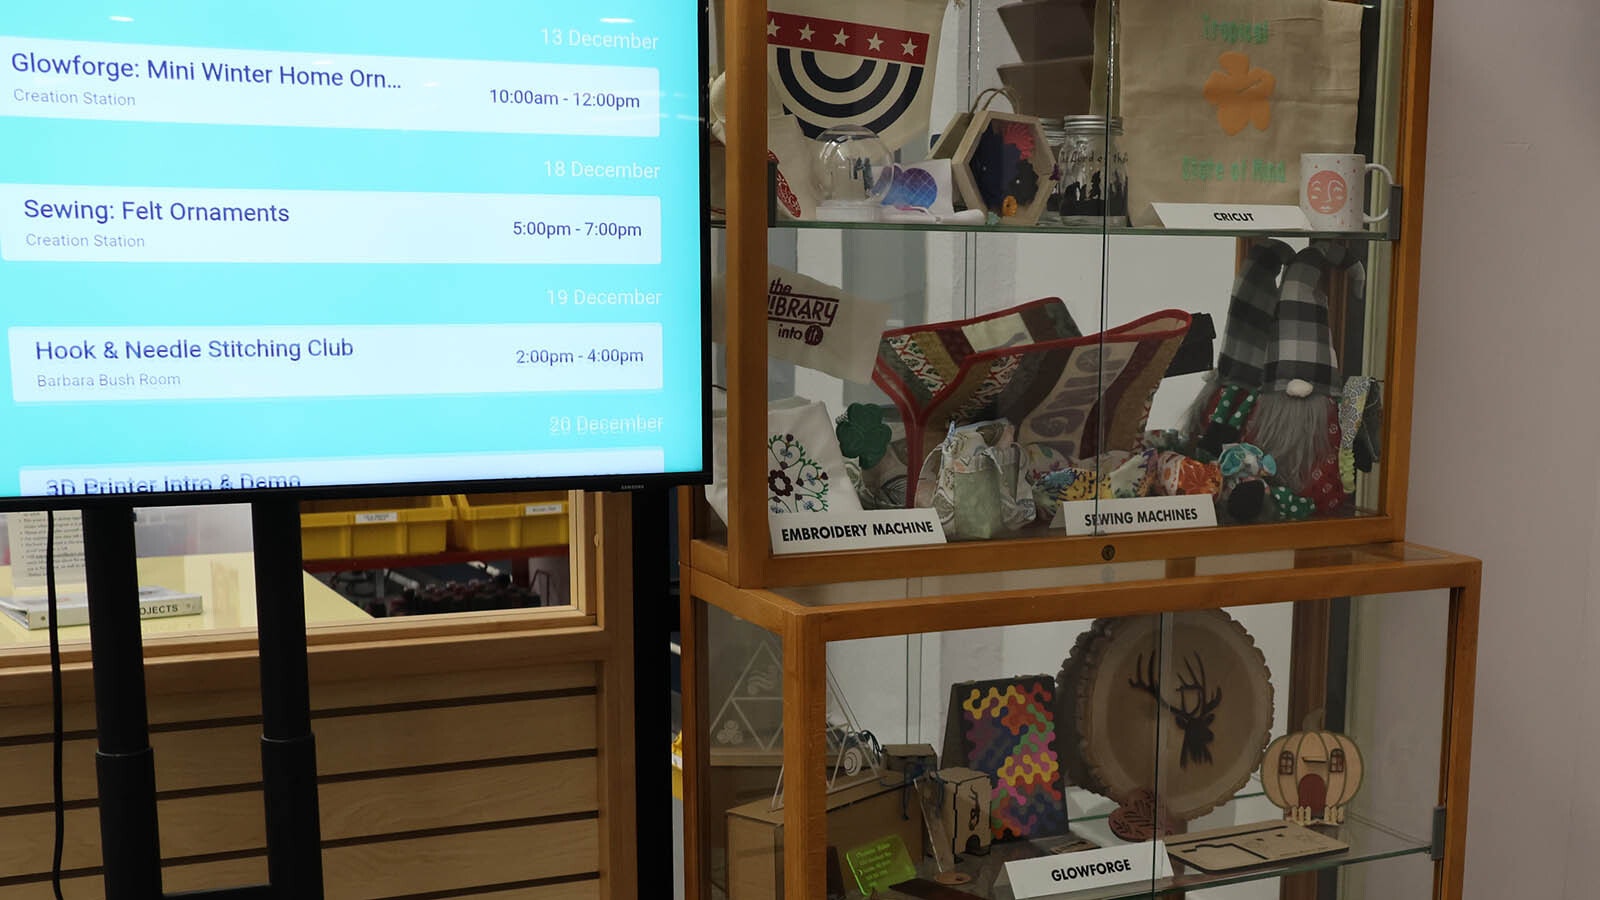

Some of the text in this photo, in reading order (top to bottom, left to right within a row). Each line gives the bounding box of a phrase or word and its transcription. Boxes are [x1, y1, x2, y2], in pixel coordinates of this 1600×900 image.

[540, 28, 660, 51] 13 December
[11, 52, 402, 90] Glowforge: Mini Winter Home Orn...
[13, 88, 137, 107] Creation Station
[489, 88, 559, 106] 10:00am
[573, 92, 641, 111] 12:00pm
[544, 160, 661, 180] 18 December
[24, 199, 290, 225] Sewing: Felt Ornaments
[1213, 212, 1255, 222] CRICUT
[513, 222, 571, 240] 5:00pm
[585, 222, 642, 240] 7:00pm
[25, 233, 146, 249] Creation Station
[768, 277, 792, 295] the
[546, 287, 662, 305] 19 December
[778, 323, 803, 340] into
[35, 337, 354, 362] Hook & Needle Stitching Club
[516, 349, 574, 367] 2:00pm
[587, 348, 644, 366] 4:00pm
[37, 371, 181, 388] Barbara Bush Room
[577, 412, 664, 435] December
[45, 472, 301, 496] 3D Printer Intro & Demo
[1084, 508, 1198, 526] SEWING MACHINES
[781, 520, 934, 542] EMBROIDERY MACHINE
[1051, 859, 1132, 882] GLOWFORGE
